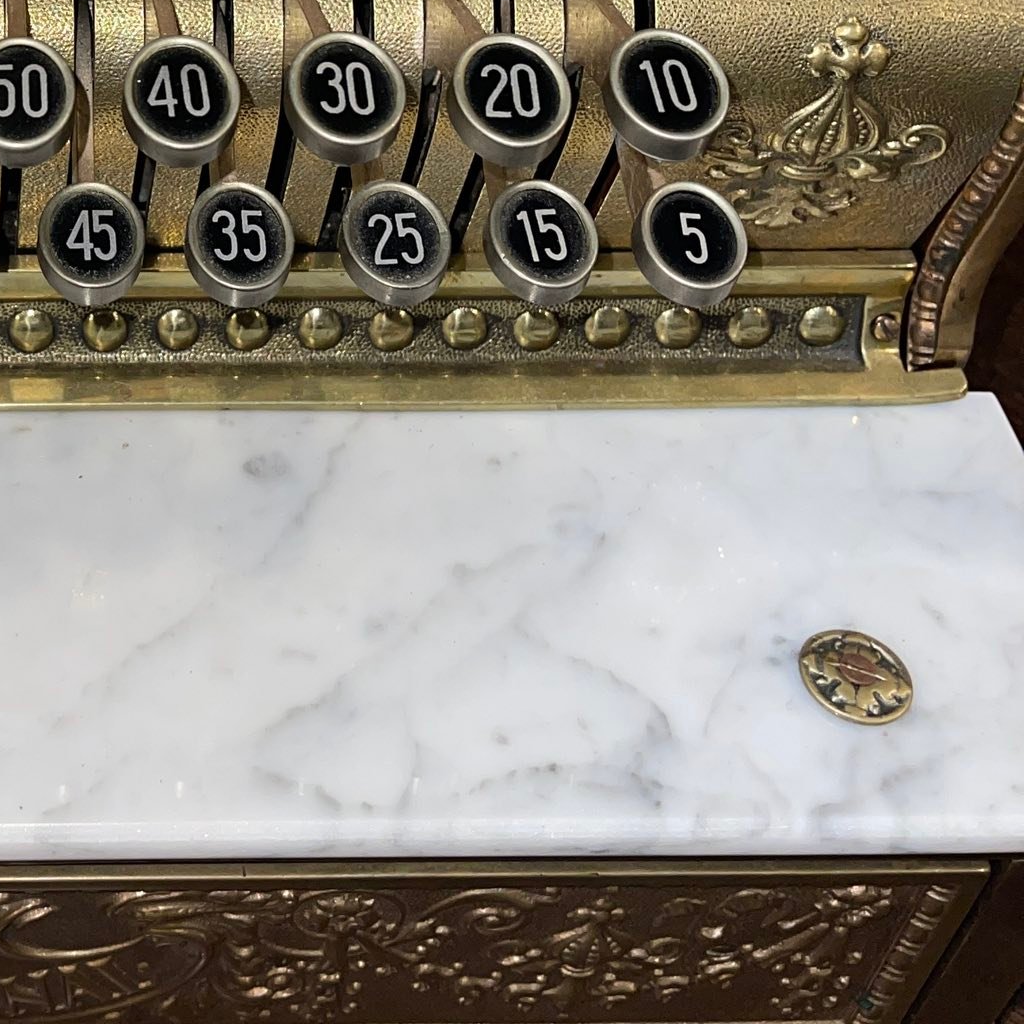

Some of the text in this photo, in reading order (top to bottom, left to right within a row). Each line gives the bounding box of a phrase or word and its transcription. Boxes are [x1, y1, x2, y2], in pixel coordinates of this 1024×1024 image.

[148, 65, 210, 116] 40
[317, 62, 374, 115] 30
[481, 64, 540, 117] 20
[640, 60, 697, 112] 10
[66, 210, 116, 260] 45
[213, 210, 266, 261] 35
[369, 213, 424, 265] 25
[517, 209, 567, 261] 15
[680, 213, 708, 264] 5
